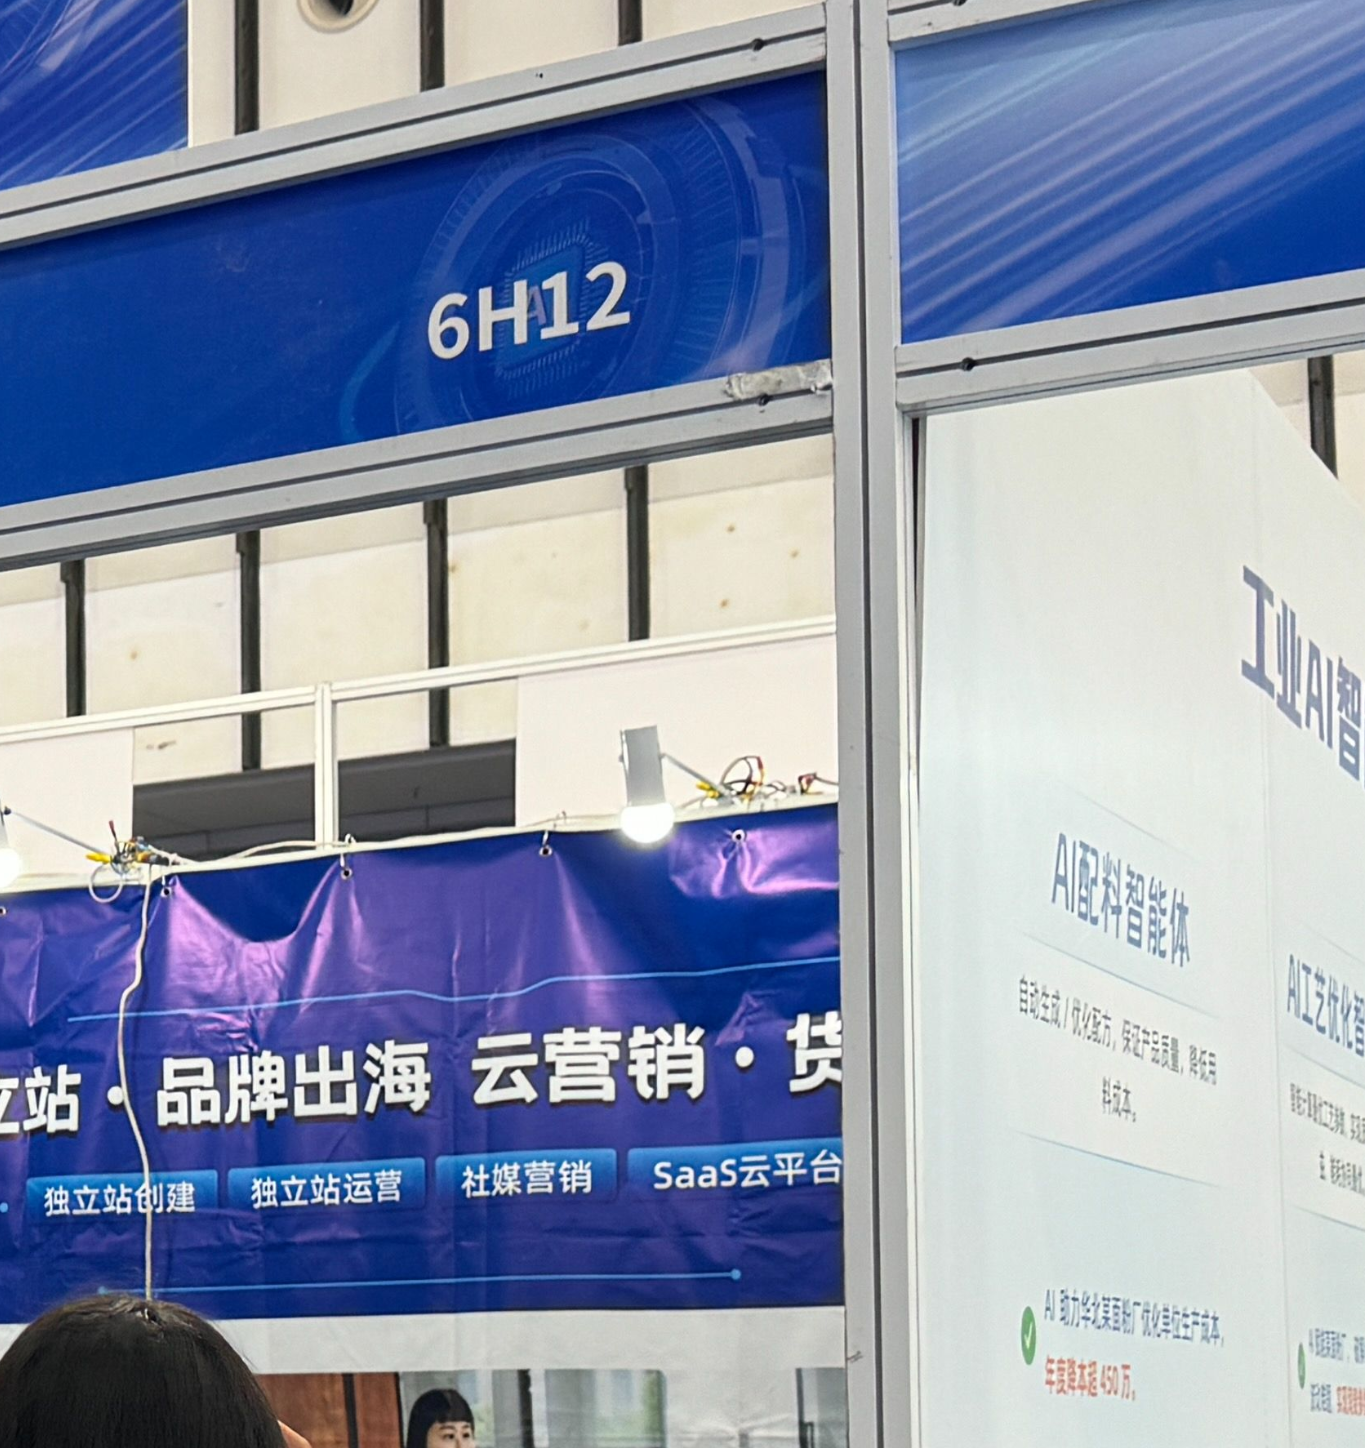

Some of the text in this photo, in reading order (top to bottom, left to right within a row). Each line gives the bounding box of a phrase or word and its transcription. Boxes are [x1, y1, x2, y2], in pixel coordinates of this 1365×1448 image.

[427, 261, 631, 360] 6H12
[1051, 832, 1191, 968] AI配料智能体
[250, 1168, 404, 1211] 独立站运营
[460, 1159, 593, 1199] 社媒营销
[652, 1149, 843, 1191] SaaS云平台
[43, 1180, 197, 1218] 独立站创建
